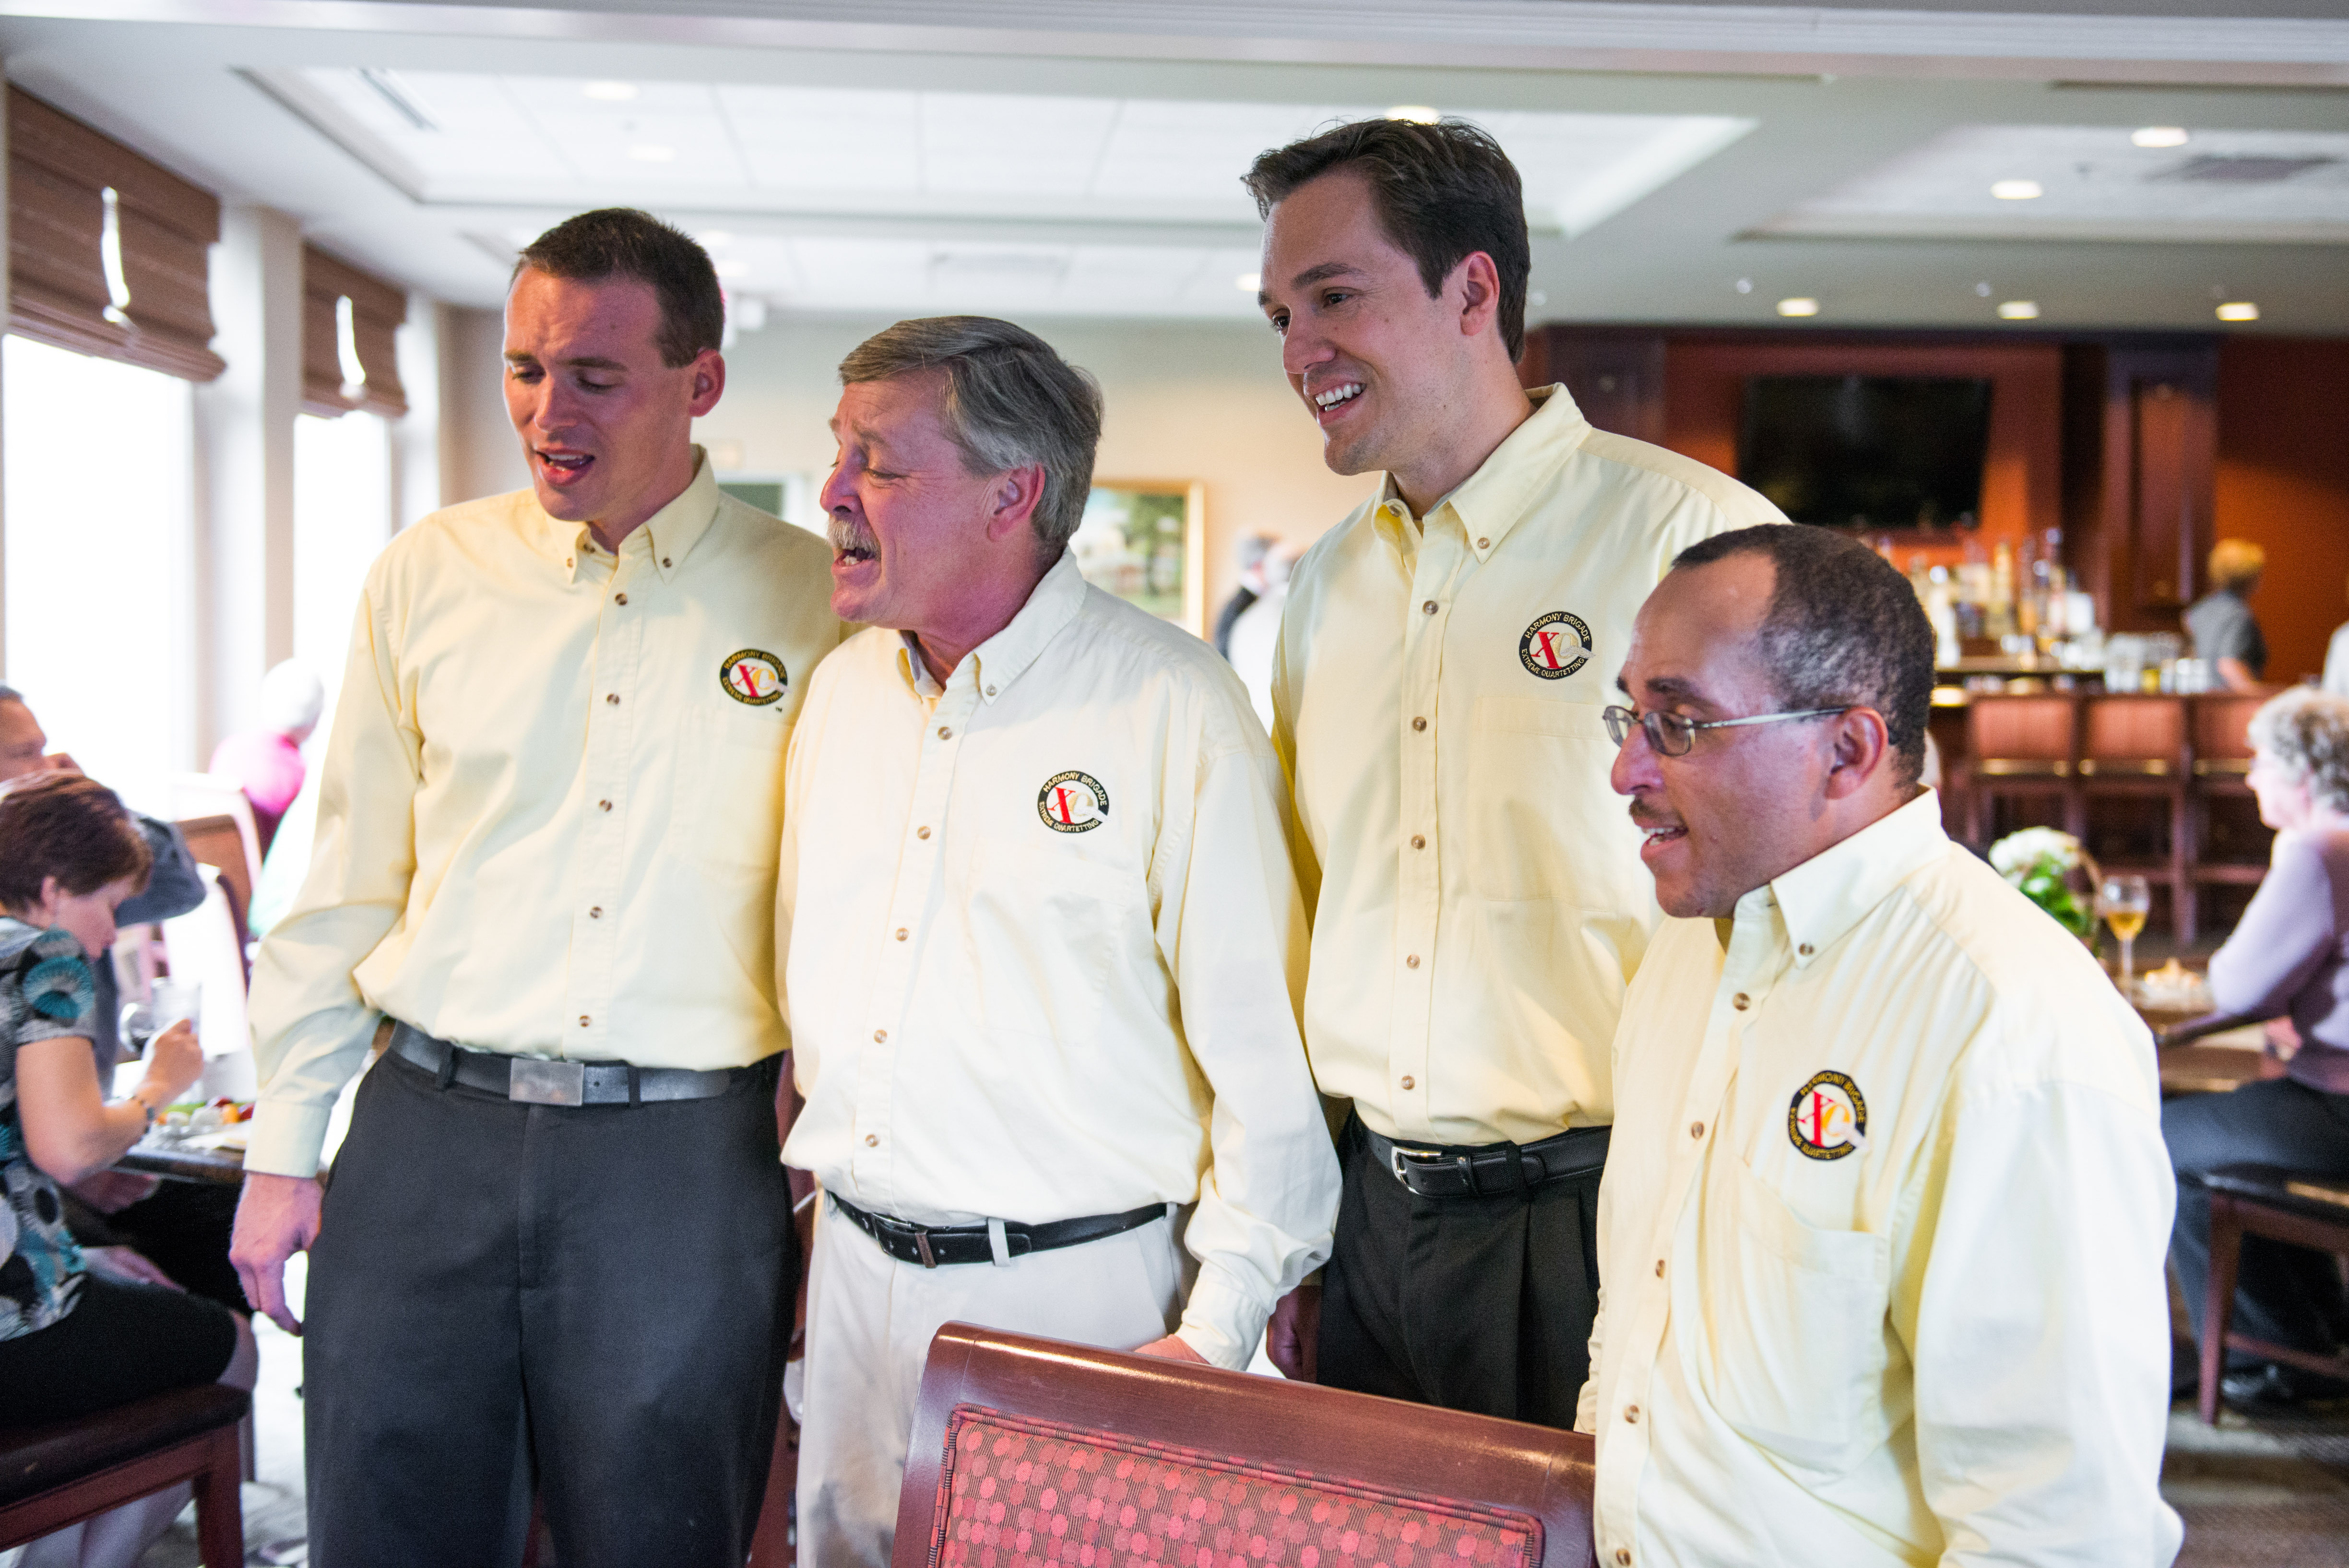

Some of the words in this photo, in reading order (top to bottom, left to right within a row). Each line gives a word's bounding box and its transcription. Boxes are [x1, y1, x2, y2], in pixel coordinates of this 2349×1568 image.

[1525, 613, 1562, 638] HARMONY
[1563, 615, 1590, 642] BRIGADE
[724, 651, 760, 669] HARMONY
[762, 654, 786, 678] BRIGADE
[1522, 648, 1540, 674] EXTREME
[1542, 658, 1584, 677] QUARTETTING
[1043, 772, 1080, 792] HARMONY
[1081, 775, 1107, 806] BRIGADE
[1039, 801, 1054, 826] EXTREME
[1054, 820, 1098, 832] QUARTETTING
